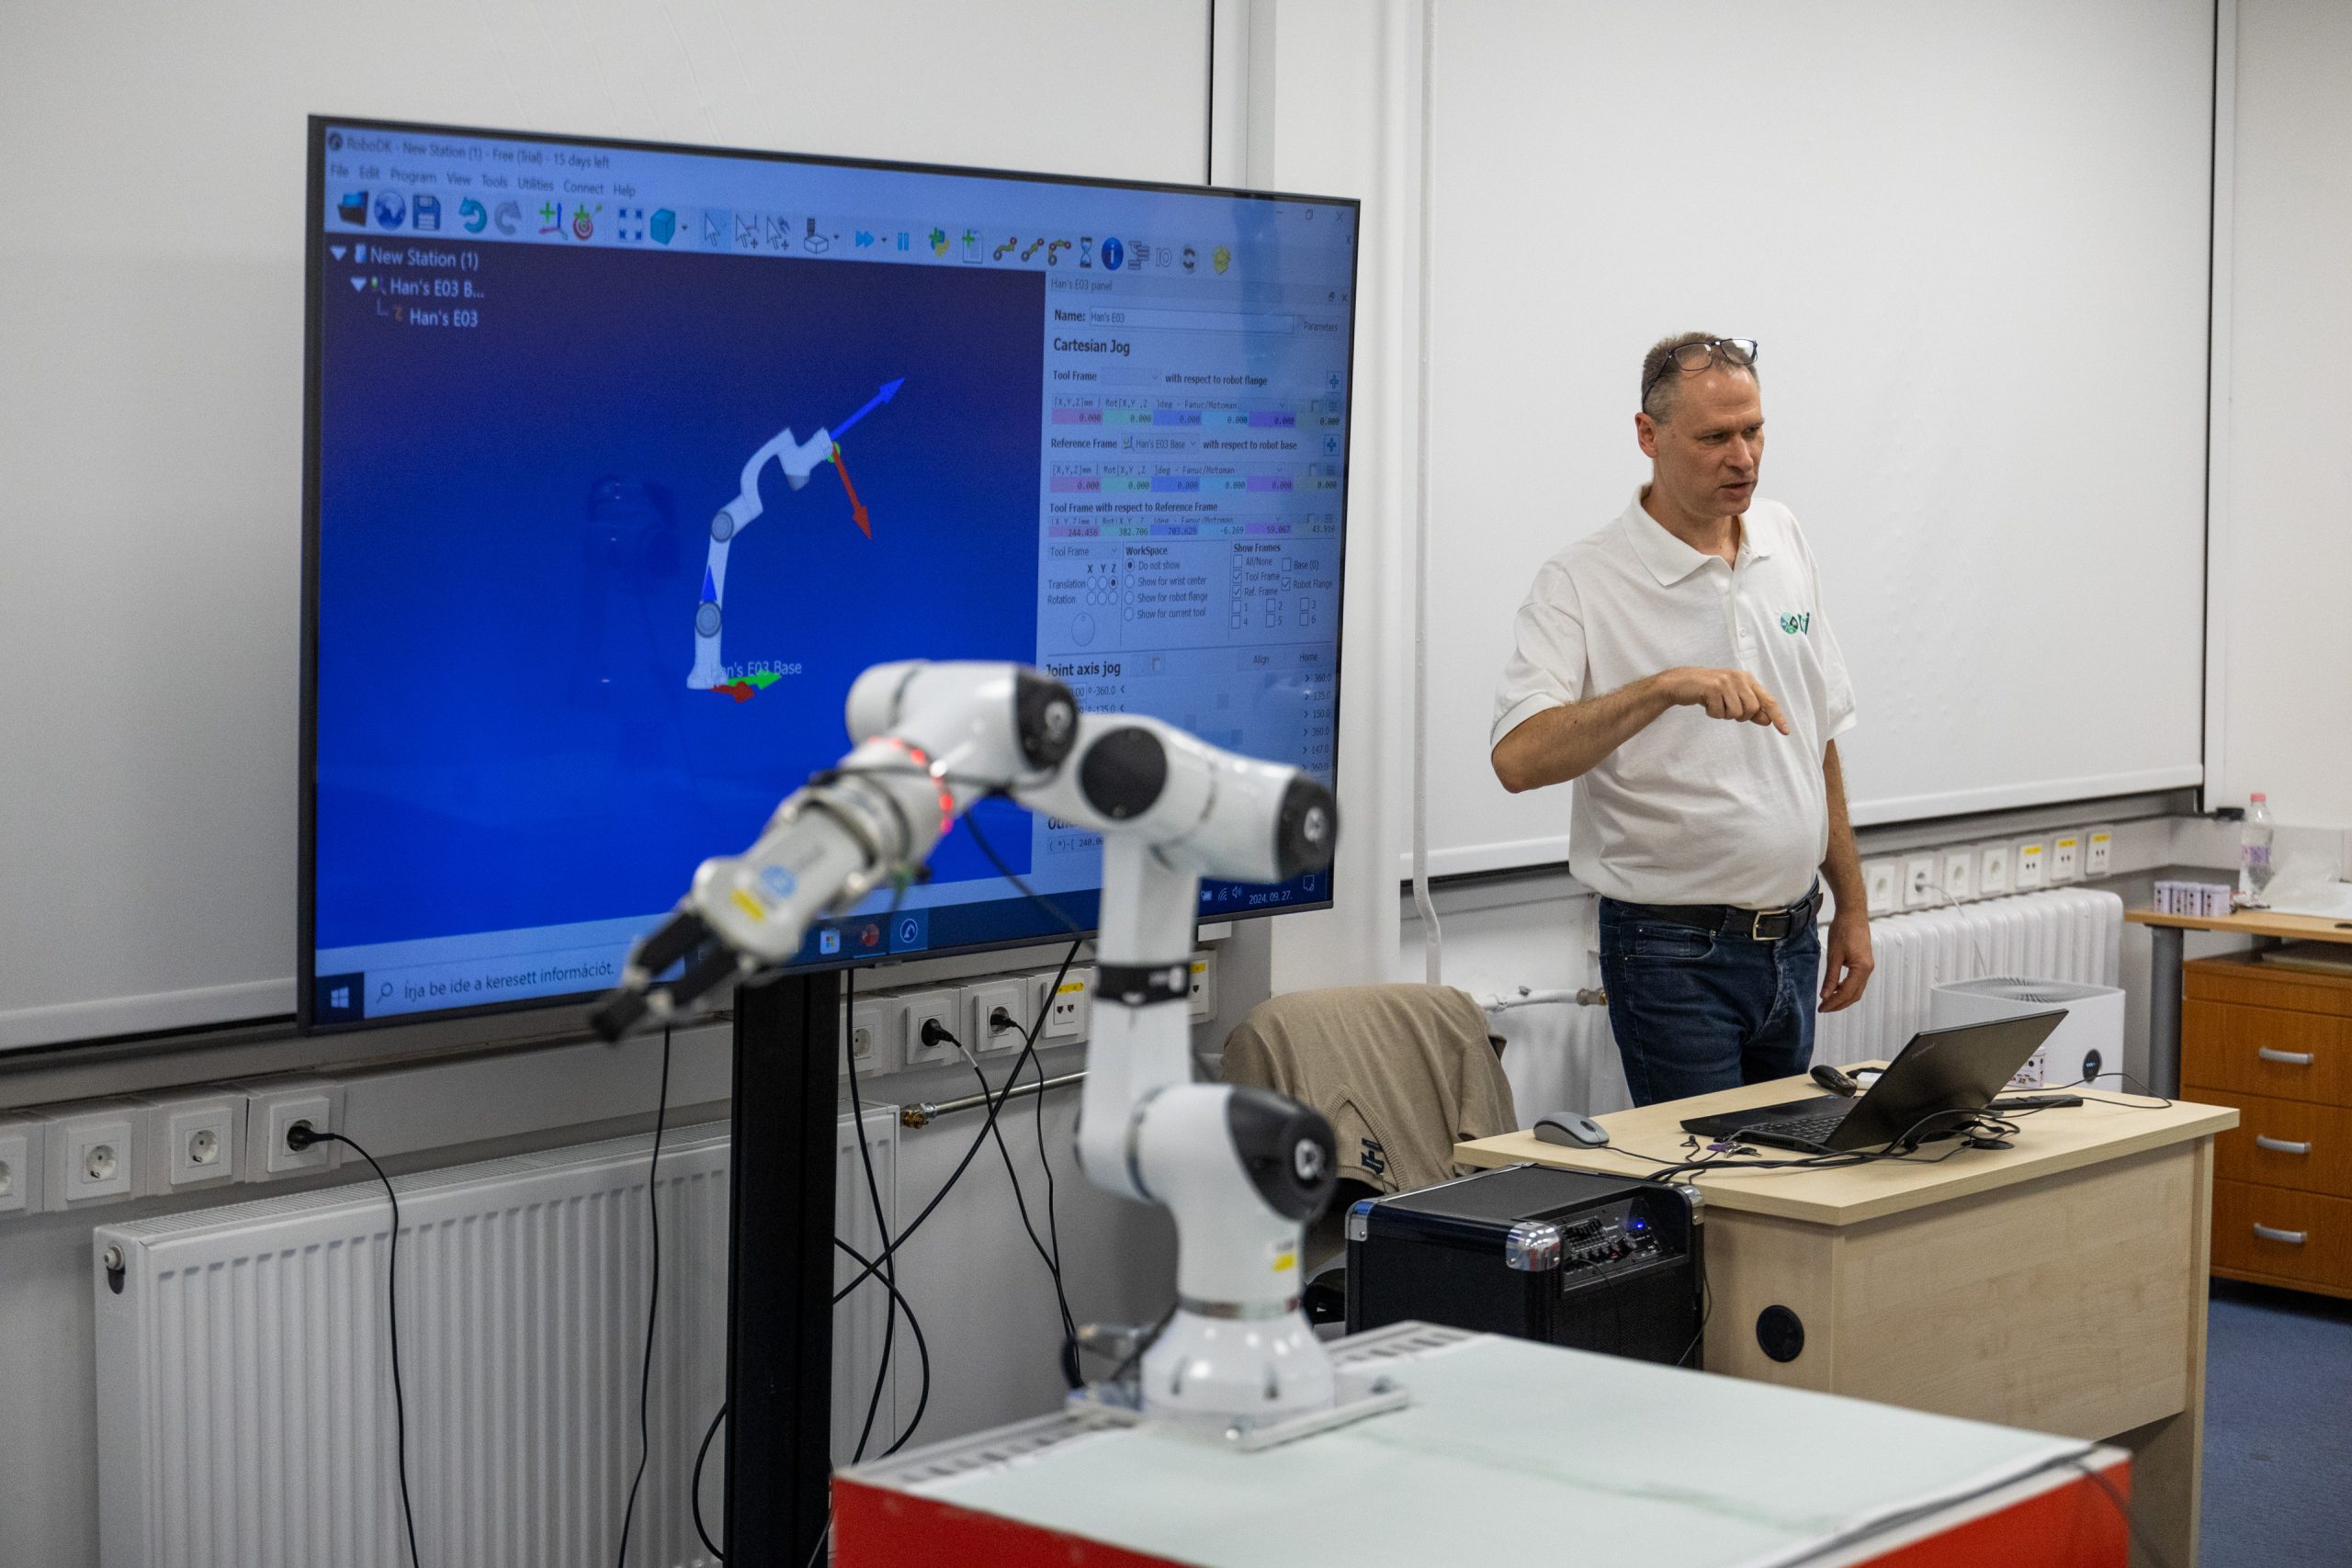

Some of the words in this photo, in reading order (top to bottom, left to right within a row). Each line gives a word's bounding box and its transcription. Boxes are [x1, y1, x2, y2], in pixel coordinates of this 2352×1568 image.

[346, 138, 391, 153] RoboDK
[402, 141, 426, 155] New
[429, 143, 466, 160] Station
[469, 146, 483, 162] (1)
[492, 148, 514, 163] Free
[516, 150, 543, 166] (Trial)
[554, 153, 565, 165] 15
[568, 155, 592, 169] days
[594, 157, 610, 169] left
[330, 164, 349, 178] File
[359, 167, 379, 180] Edit
[390, 168, 437, 187] Program
[447, 173, 471, 186] View
[481, 175, 508, 188] Tools
[517, 177, 554, 192] Utilities
[563, 181, 604, 196] Connect
[613, 185, 637, 199] Help
[370, 245, 404, 265] New
[407, 247, 457, 267] Station
[460, 251, 479, 271] (1)
[390, 277, 430, 295] Han's
[434, 278, 459, 298] E03
[1051, 278, 1072, 289] Han's
[1091, 281, 1112, 294] panel
[410, 308, 449, 326] Han's
[453, 309, 479, 327] E03
[1055, 310, 1085, 321] Name:
[1091, 313, 1110, 321] Han's
[1054, 338, 1107, 353] Cartesian
[1110, 340, 1130, 356] Jog
[1054, 370, 1069, 380] Tool
[1073, 371, 1097, 381] Frame
[1165, 374, 1182, 383] with
[1182, 375, 1211, 384] respect
[1214, 376, 1221, 384] to
[1223, 375, 1242, 385] robot
[1245, 376, 1267, 387] flange
[1051, 438, 1091, 448] Reference
[1093, 438, 1117, 448] Frame
[1136, 440, 1153, 448] Han's
[1170, 440, 1185, 448] Base
[1204, 440, 1219, 449] with
[1221, 441, 1248, 451] respect
[1250, 441, 1257, 449] to
[1260, 440, 1278, 449] robot
[1281, 441, 1296, 449] base
[1050, 502, 1066, 513] Tool
[1069, 503, 1093, 513] Frame
[1096, 503, 1112, 513] with
[1115, 503, 1145, 513] respect
[1145, 502, 1152, 512] to
[1155, 502, 1193, 512] Reference
[1195, 502, 1217, 512] Frame
[1050, 547, 1066, 557] Tool
[1068, 547, 1090, 556] Frame
[1125, 547, 1168, 556] WorkSpace
[1234, 543, 1253, 552] Show
[1255, 543, 1281, 552] Frames
[1138, 561, 1148, 570] Do
[1150, 561, 1161, 570] not
[1163, 560, 1180, 569] show
[1246, 558, 1272, 567] All/None
[1295, 561, 1307, 570] Base
[1087, 564, 1093, 573] X
[1101, 564, 1105, 573] Y
[1111, 564, 1116, 573] Z
[1138, 578, 1156, 587] Show
[1158, 578, 1167, 586] for
[1187, 576, 1206, 585] center
[1261, 572, 1281, 581] Frame
[1048, 579, 1086, 589] Translation
[1294, 580, 1311, 588] Robot
[1313, 580, 1333, 589] Flange
[1244, 588, 1257, 596] Ref.
[1259, 587, 1278, 595] Frame
[1047, 595, 1076, 604] Rotation
[1137, 593, 1156, 603] Show
[1158, 593, 1167, 602] for
[1169, 592, 1186, 601] robot
[1189, 592, 1207, 602] flange
[1279, 602, 1282, 610] 2
[1312, 600, 1316, 609] 3
[1137, 609, 1155, 618] Show
[1158, 609, 1167, 617] for
[1169, 608, 1192, 617] current
[1193, 607, 1205, 616] tool
[1278, 616, 1282, 625] 5
[1311, 615, 1316, 624] 6
[1253, 655, 1271, 665] Align
[774, 660, 802, 675] Base
[1077, 662, 1099, 675] axis
[1102, 661, 1120, 677] jog
[1250, 894, 1267, 904] 2024.
[1270, 892, 1280, 902] 09.
[430, 982, 446, 997] be
[450, 978, 469, 993] ide
[474, 979, 481, 991] a
[486, 970, 537, 989] keresett
